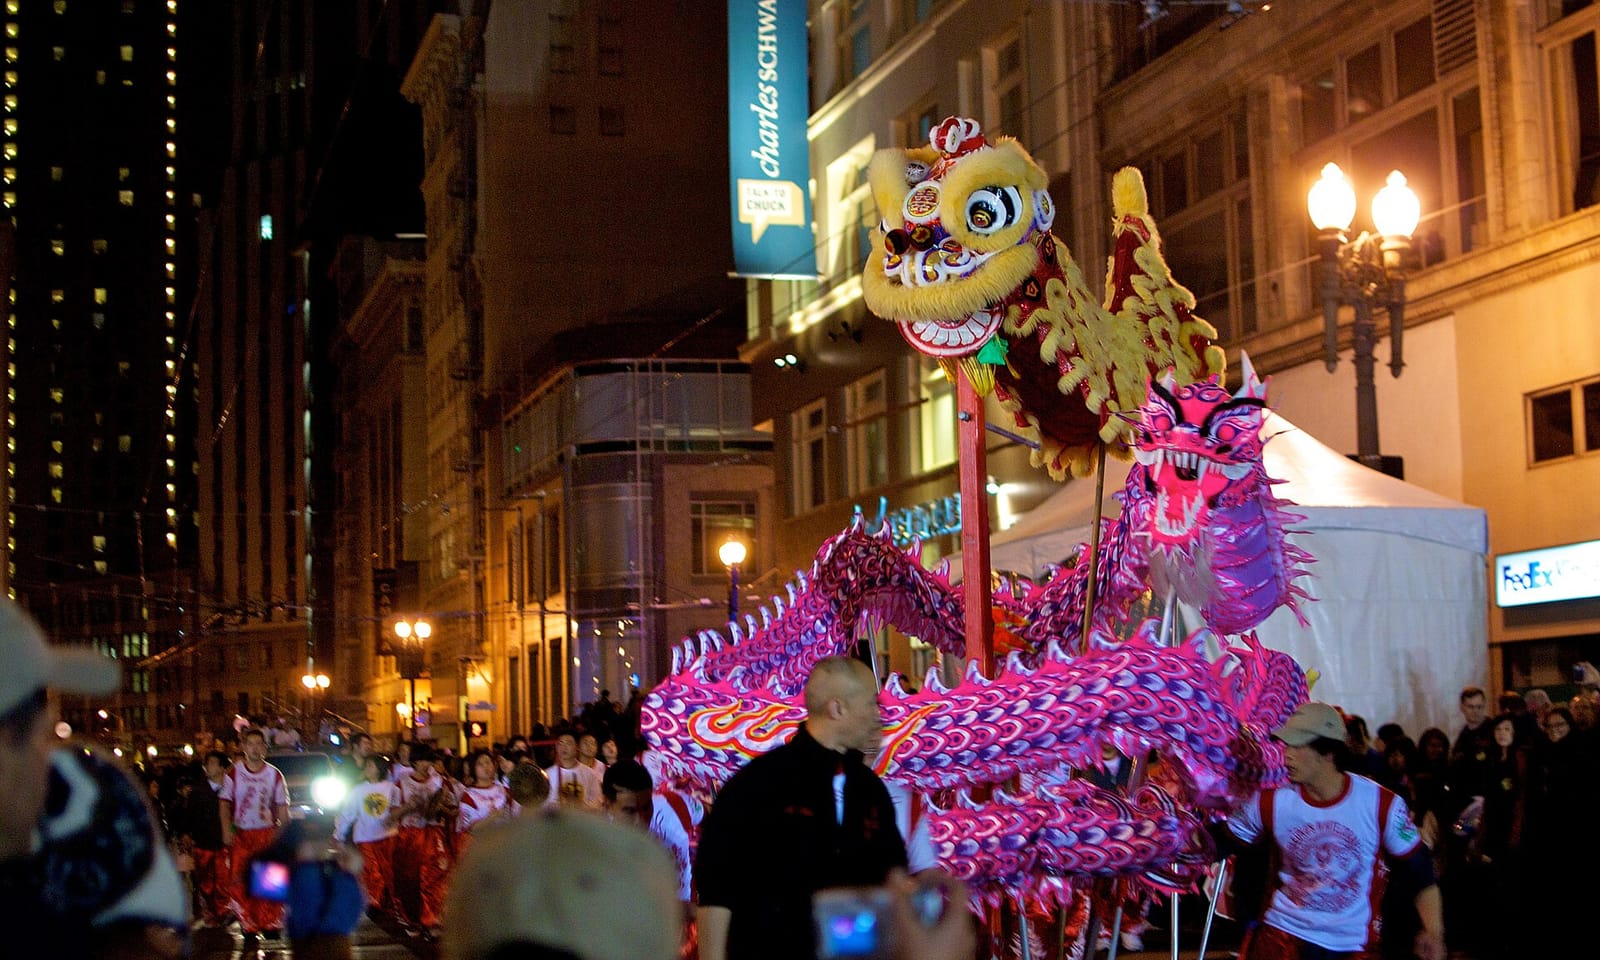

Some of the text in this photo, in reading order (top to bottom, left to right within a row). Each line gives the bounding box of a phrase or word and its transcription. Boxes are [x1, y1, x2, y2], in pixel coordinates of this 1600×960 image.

[750, 83, 780, 178] charles
[746, 199, 786, 211] CHUCK
[1503, 561, 1553, 592] FedEx
